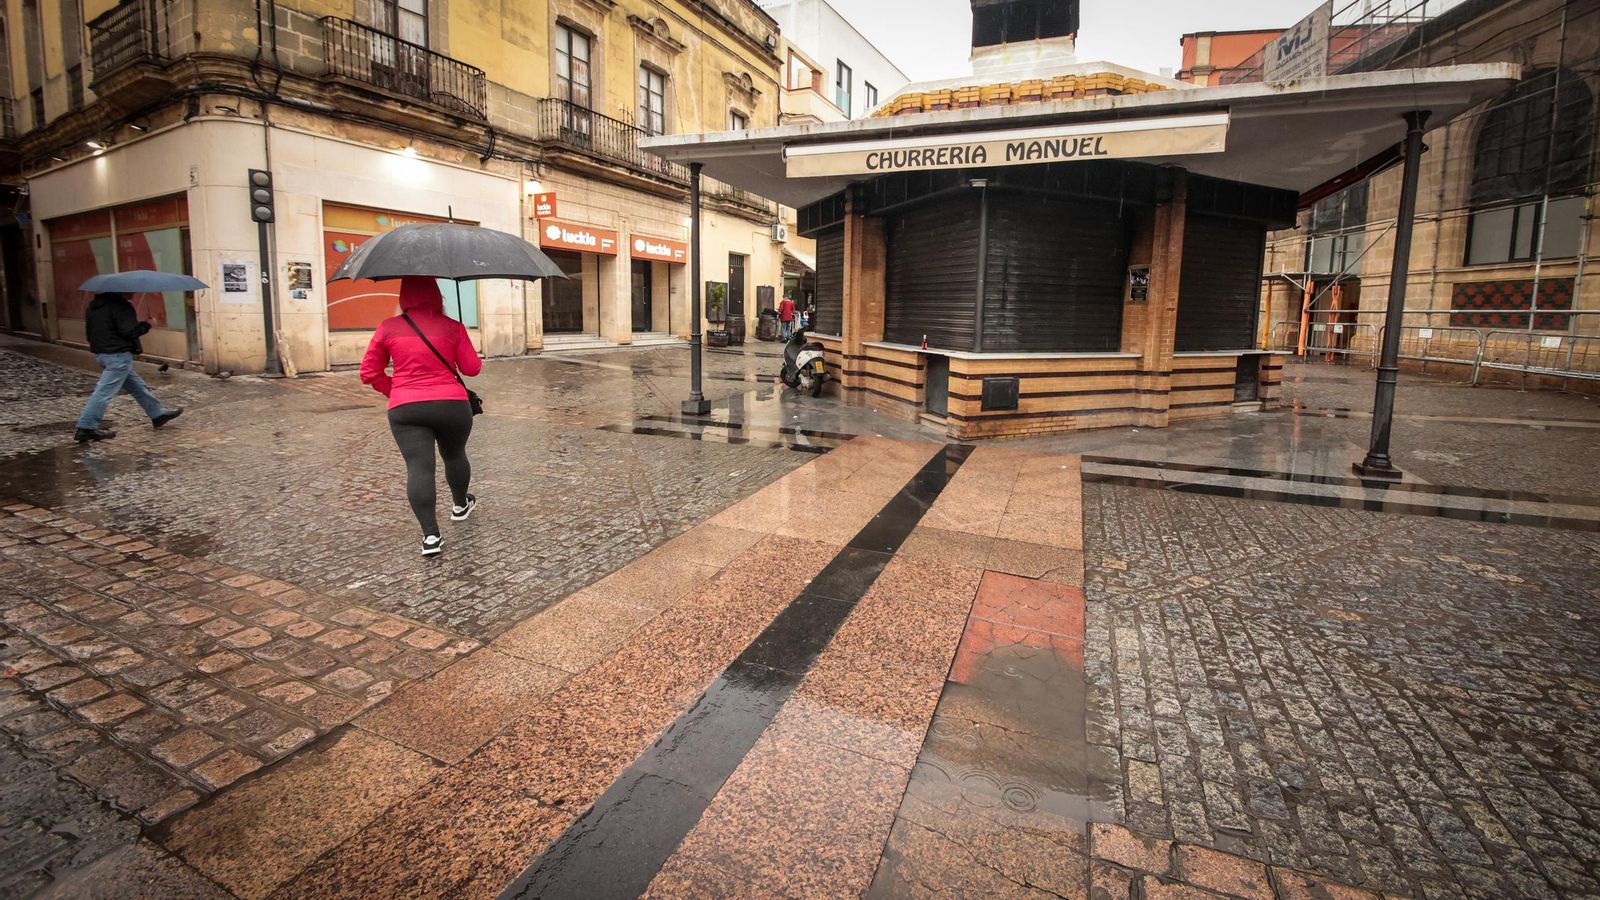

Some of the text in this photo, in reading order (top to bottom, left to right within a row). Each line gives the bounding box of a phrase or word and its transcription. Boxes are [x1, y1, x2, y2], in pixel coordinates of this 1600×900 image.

[1277, 14, 1313, 61] MJ
[866, 136, 1108, 170] CHURRERIA MANUEL
[562, 228, 596, 246] luckia
[646, 241, 672, 256] luckia
